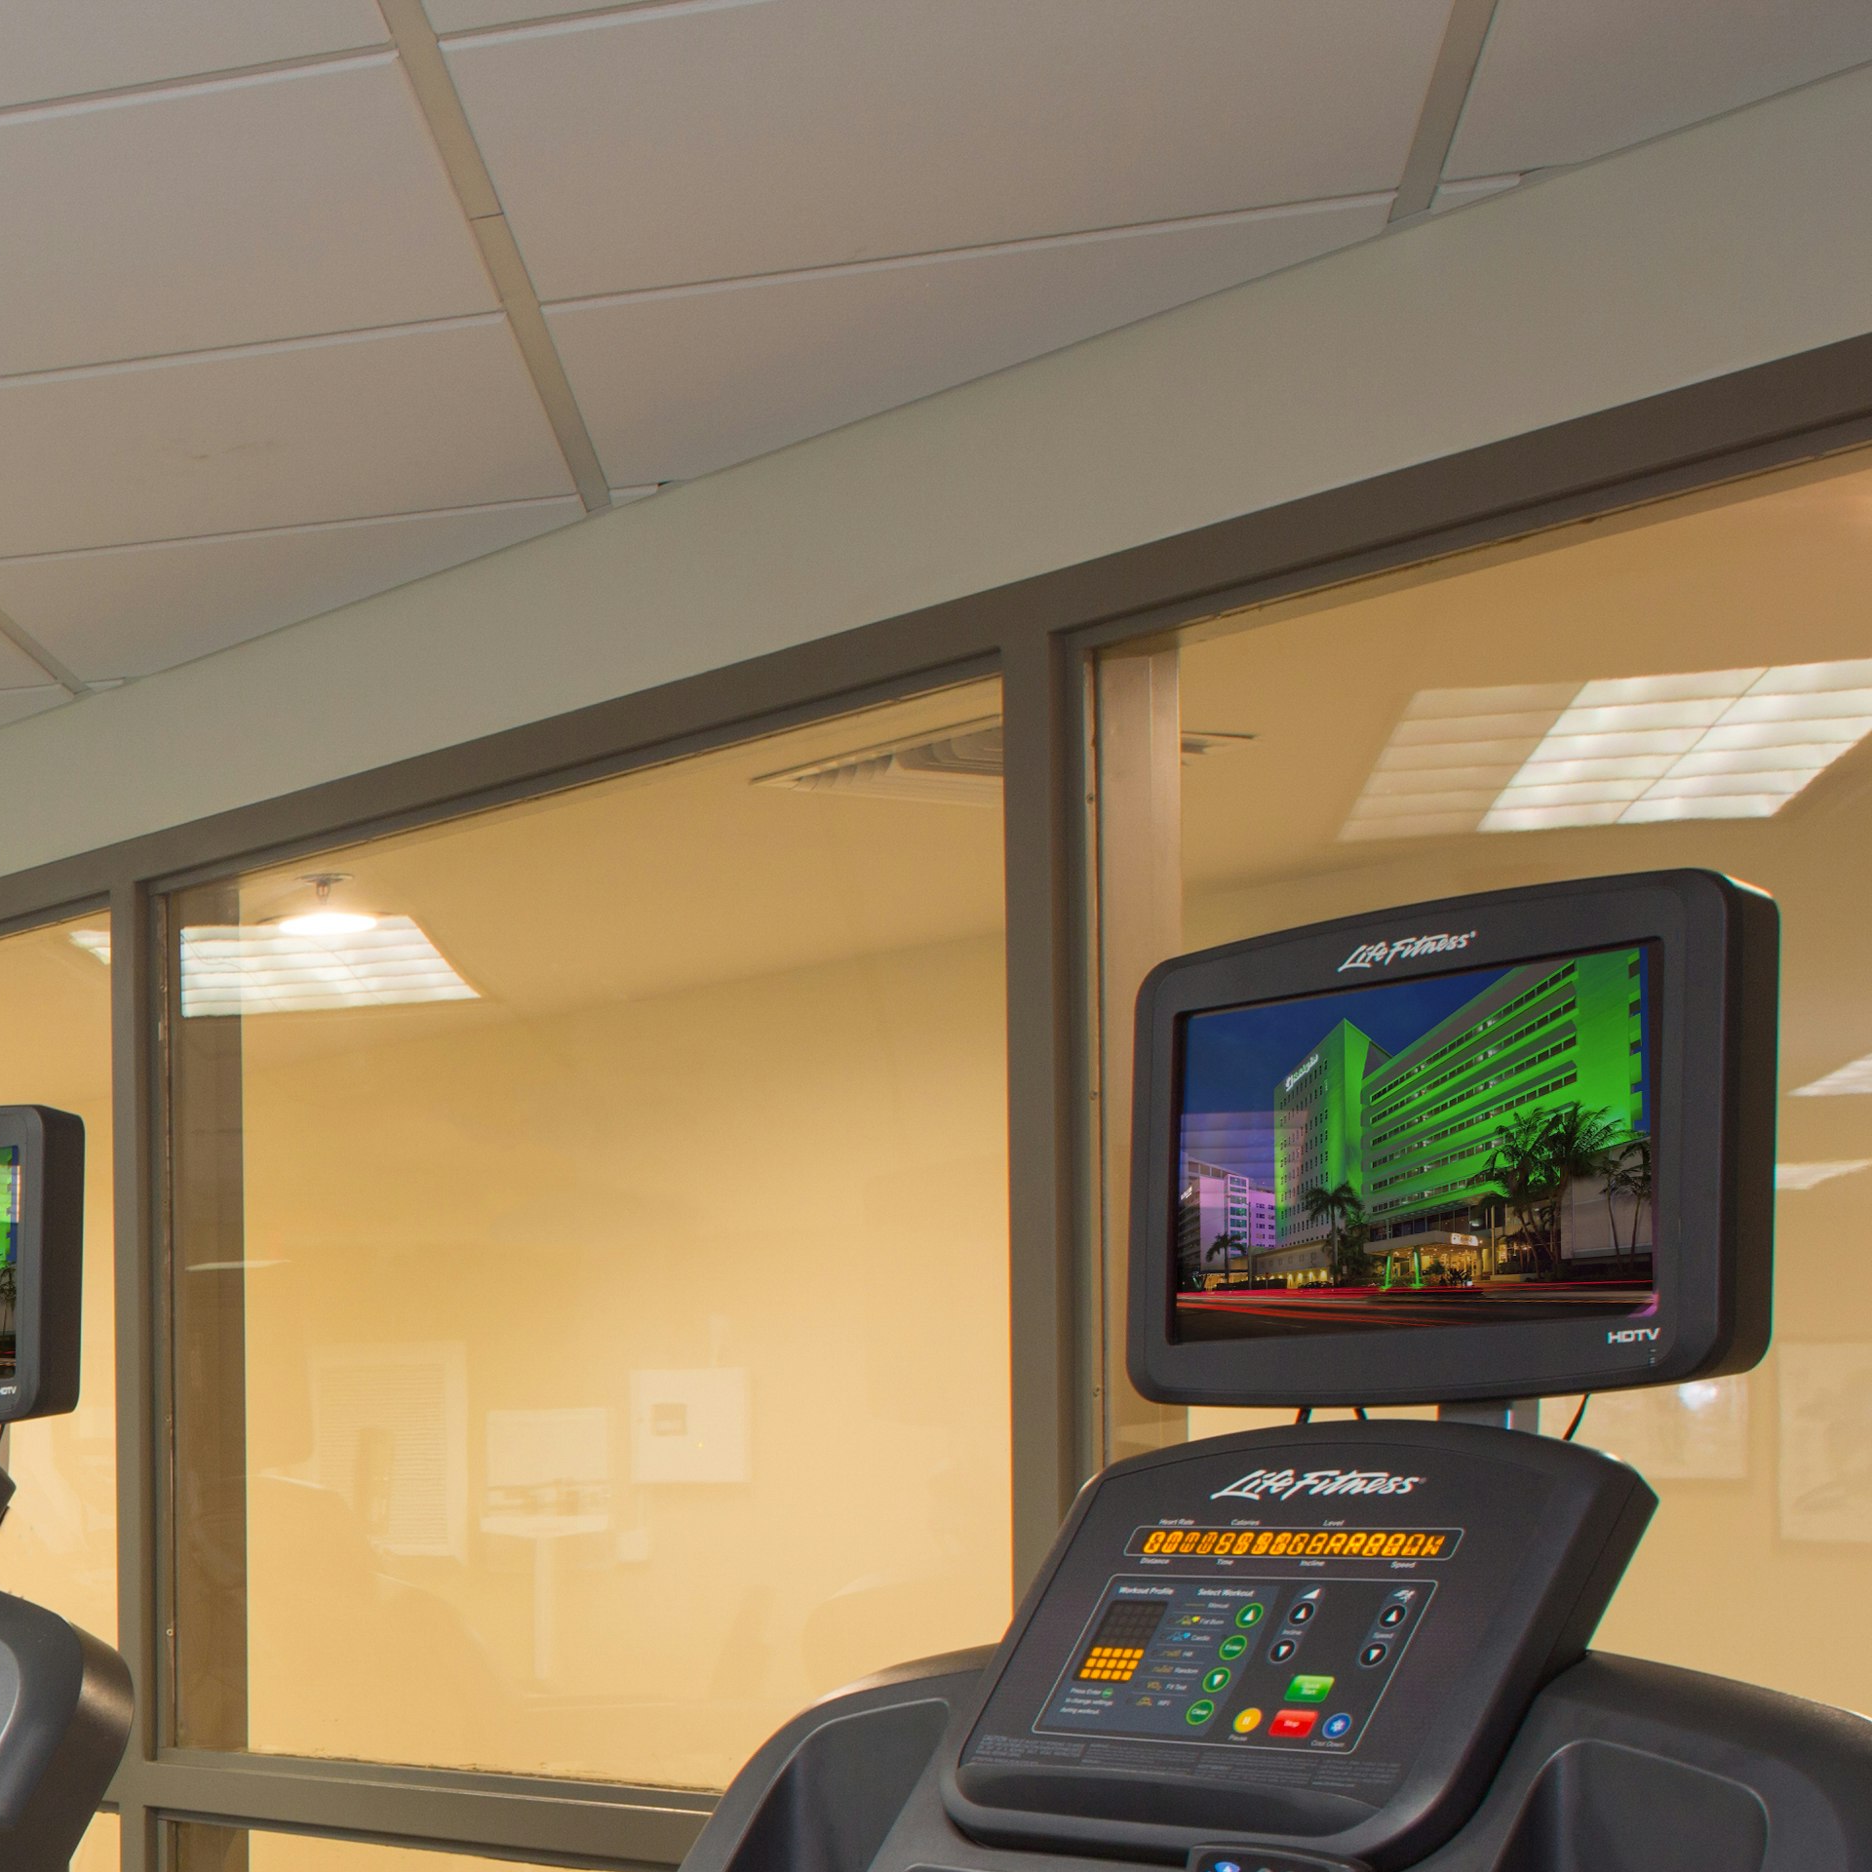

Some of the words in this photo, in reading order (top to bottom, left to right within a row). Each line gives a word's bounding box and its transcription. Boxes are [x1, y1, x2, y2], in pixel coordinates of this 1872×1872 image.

[1608, 1328, 1661, 1344] HDTV
[1323, 1519, 1344, 1527] Level
[1391, 1561, 1415, 1569] Speed
[1198, 1588, 1221, 1596] Select
[1222, 1589, 1255, 1597] Workout
